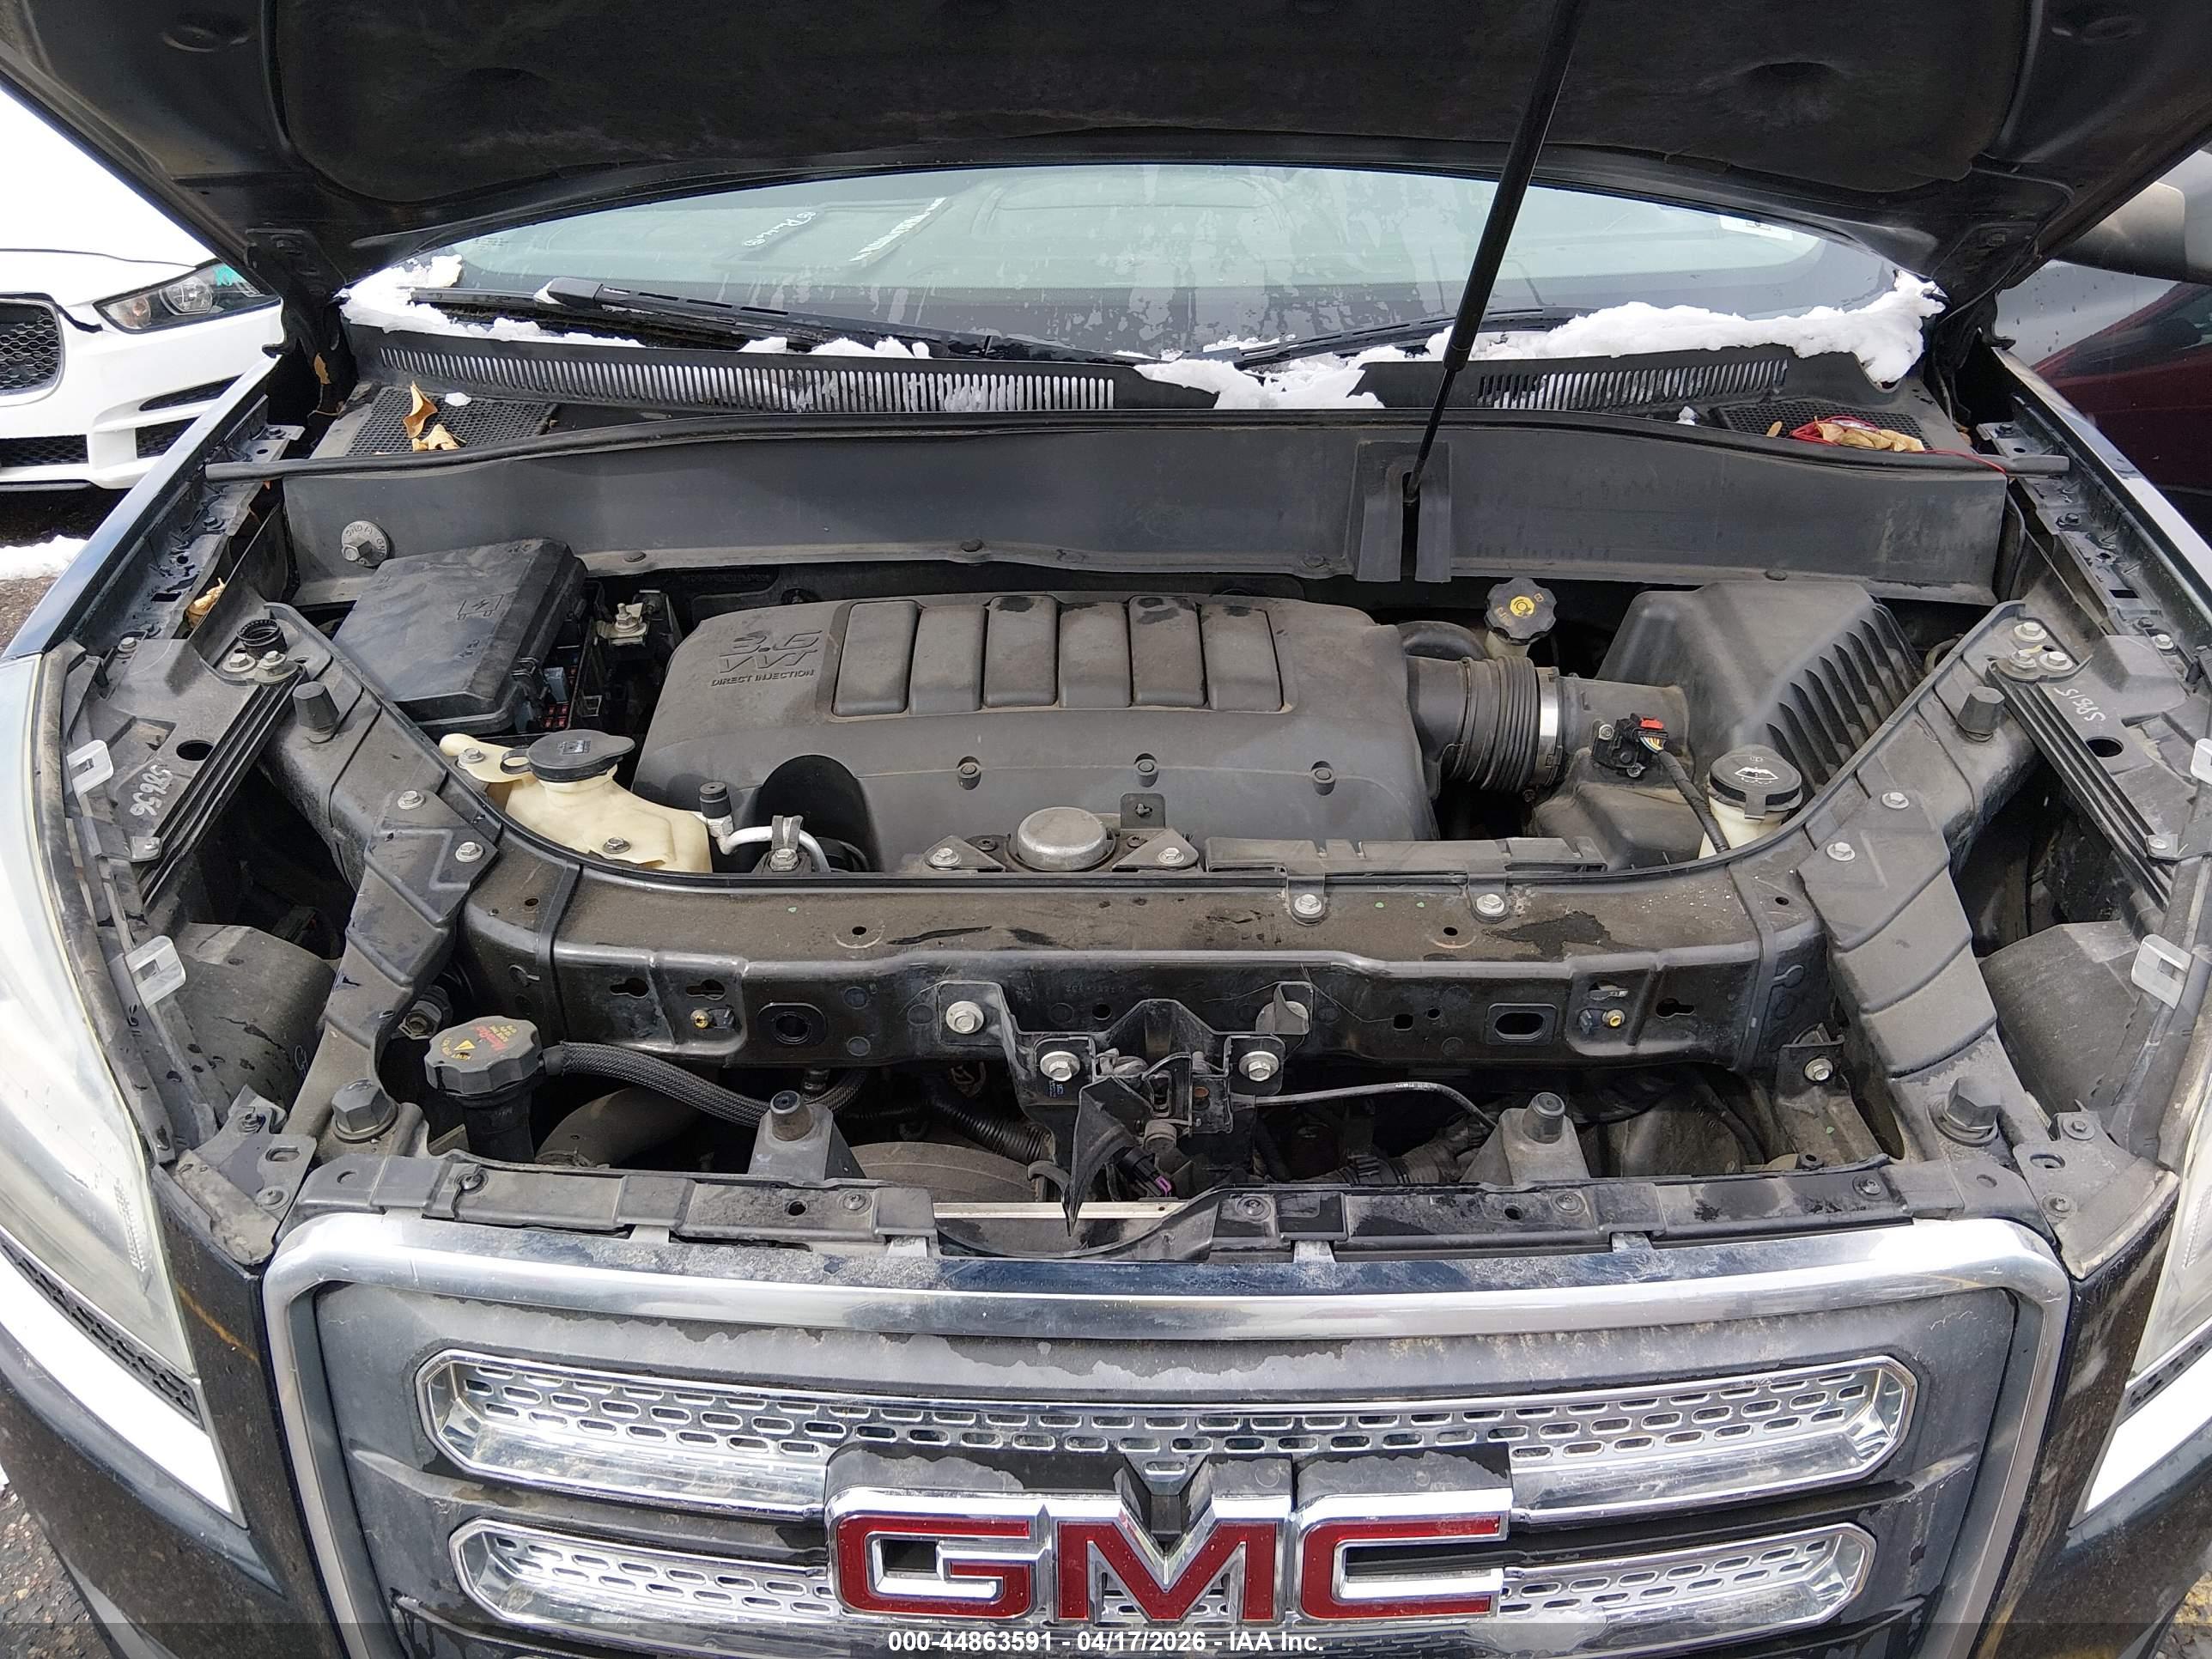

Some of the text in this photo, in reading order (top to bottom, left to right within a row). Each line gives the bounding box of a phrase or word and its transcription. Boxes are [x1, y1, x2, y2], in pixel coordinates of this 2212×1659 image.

[730, 630, 823, 654] 3.6
[711, 669, 815, 687] DIRECT INJECTION
[828, 1490, 1511, 1623] GMC
